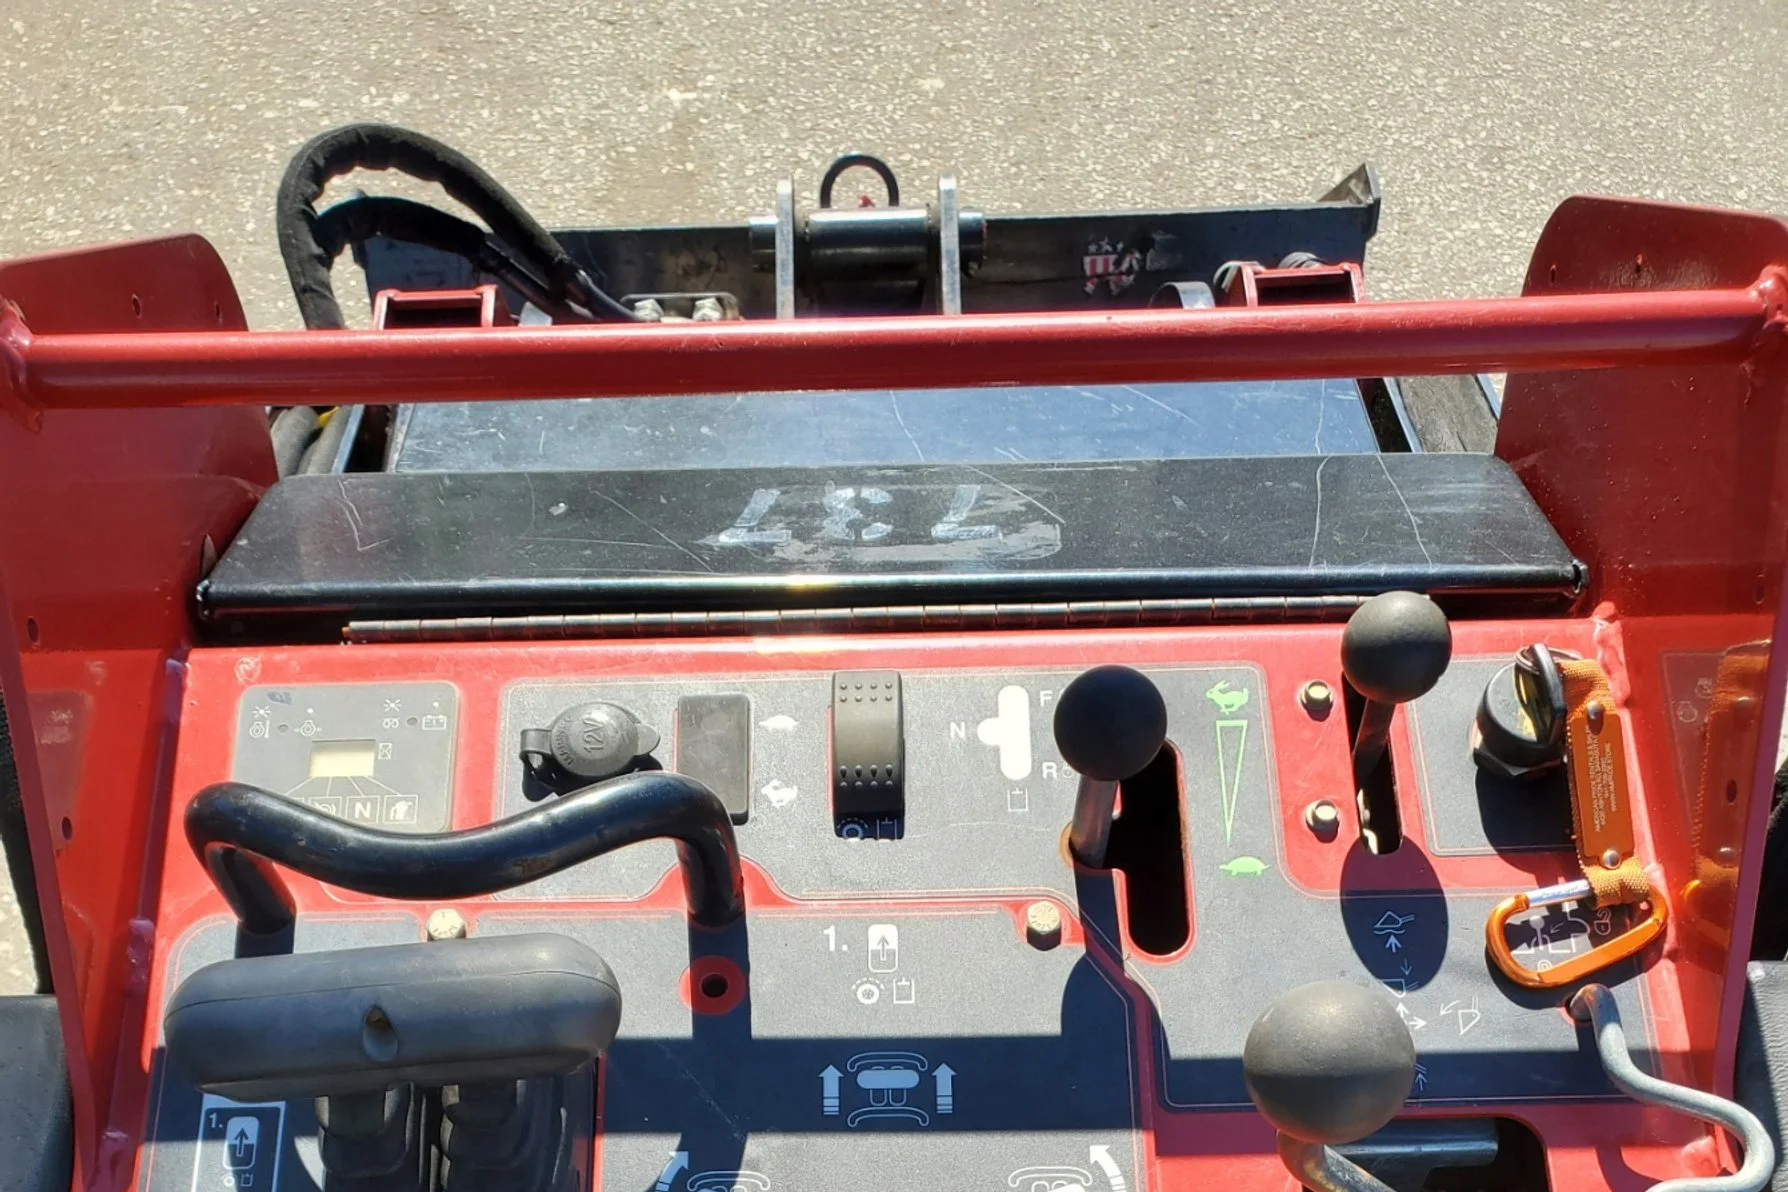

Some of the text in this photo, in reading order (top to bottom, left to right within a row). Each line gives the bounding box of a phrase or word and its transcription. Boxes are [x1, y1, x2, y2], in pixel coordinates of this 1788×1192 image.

[1039, 690, 1053, 708] F
[582, 717, 605, 754] 12V
[949, 722, 967, 743] N
[1042, 762, 1058, 779] R
[354, 801, 371, 818] N
[822, 927, 848, 952] 1.
[209, 1113, 223, 1129] 1.
